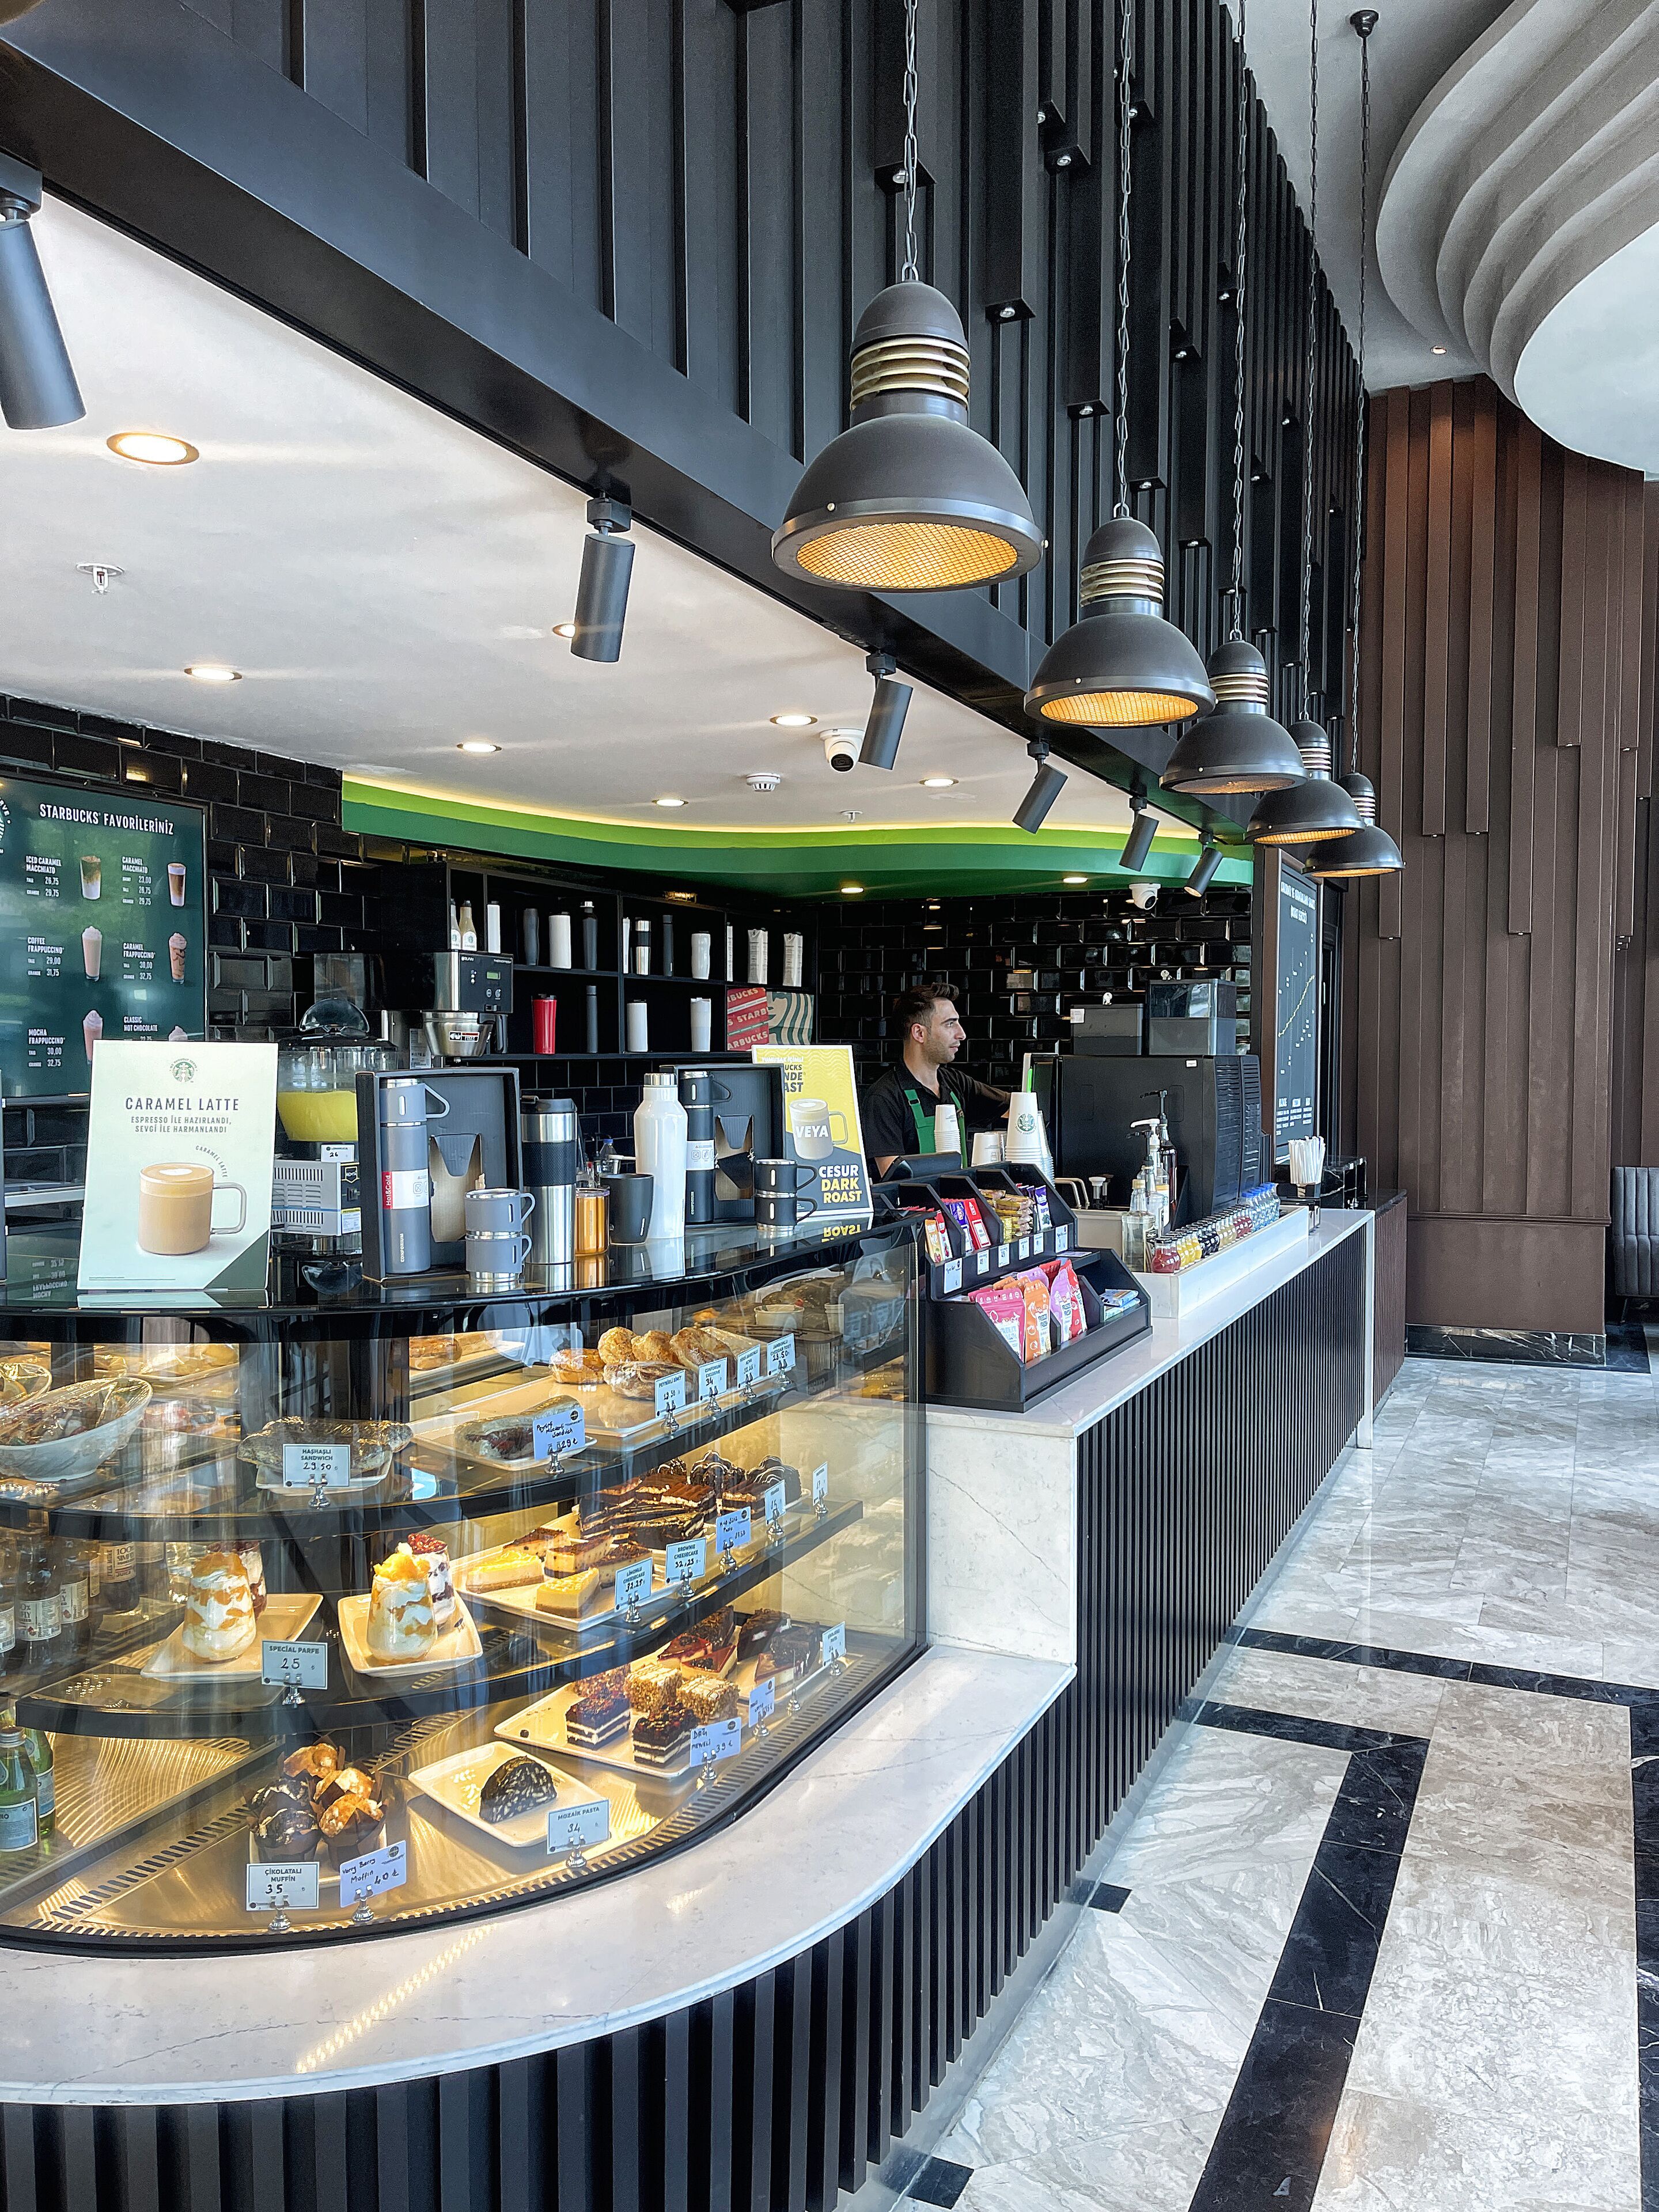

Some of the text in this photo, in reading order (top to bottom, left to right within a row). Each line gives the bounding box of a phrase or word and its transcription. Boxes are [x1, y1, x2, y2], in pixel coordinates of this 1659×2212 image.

[39, 804, 173, 835] STARBUCKS FAVORİLERİNİZ
[26, 855, 62, 866] ICED CARAMEL
[122, 857, 143, 865] CARAMEL
[26, 864, 55, 874] MACCHIATO
[122, 864, 148, 873] MACCHIATO
[28, 937, 46, 945] COFFEE
[123, 942, 143, 950] CARAMEL
[125, 1097, 239, 1111] CARAMEL LATTE
[184, 1117, 232, 1125] HAZIRLANDI,
[135, 1124, 157, 1132] SEVGİ
[795, 1125, 828, 1138] VEYA
[195, 1145, 228, 1177] CARAMEL LATTE
[819, 1164, 859, 1177] CESUR
[821, 1177, 859, 1191] DARK
[824, 1190, 862, 1203] ROAST
[706, 1377, 713, 1387] 34
[281, 1658, 300, 1669] 25
[582, 1806, 600, 1815] PASTA
[567, 1823, 580, 1833] 34
[264, 1868, 302, 1876] ÇİKOLATALI
[350, 1870, 373, 1884] Muffin
[374, 1873, 389, 1885] 40
[265, 1884, 283, 1894] 35
